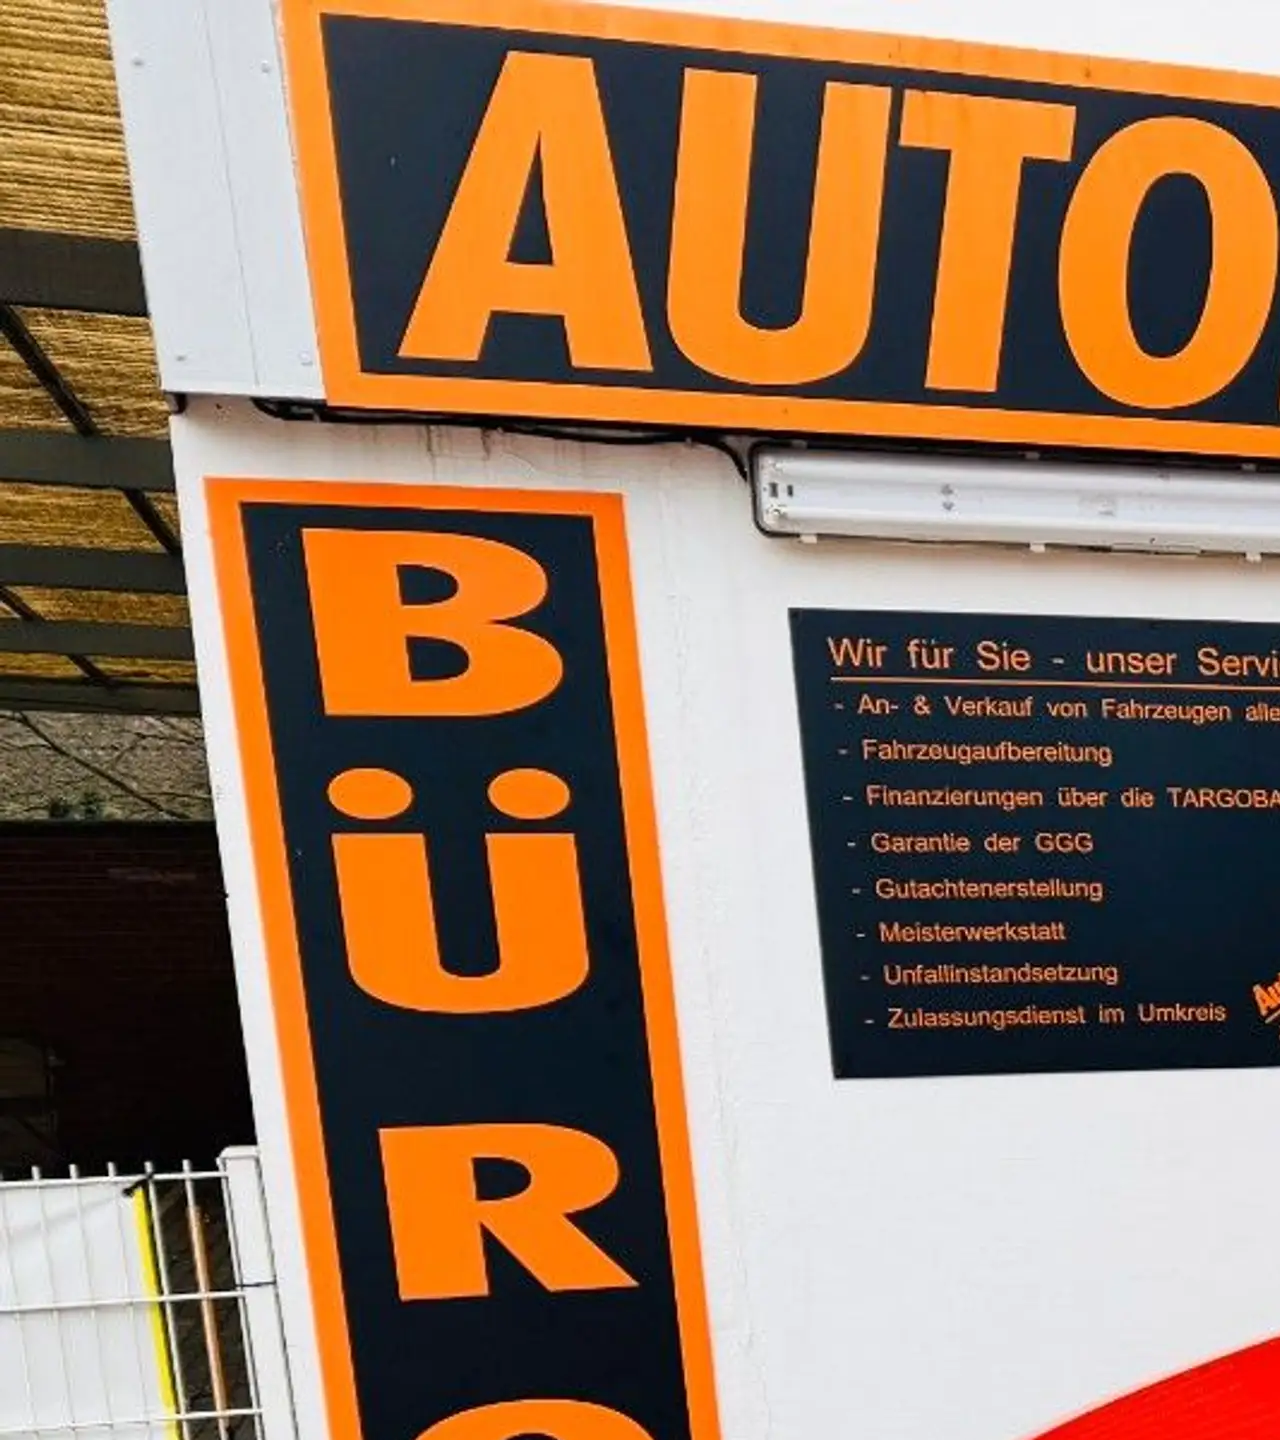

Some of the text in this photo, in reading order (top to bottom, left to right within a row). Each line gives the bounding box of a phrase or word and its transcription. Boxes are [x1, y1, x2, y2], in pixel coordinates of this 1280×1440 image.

[827, 637, 887, 669] Wir
[907, 639, 953, 669] für
[976, 640, 1031, 672] Sie
[1086, 651, 1177, 675] unser
[857, 694, 899, 715] An-
[913, 696, 931, 715] &
[944, 695, 1033, 717] Verkauf
[1046, 700, 1087, 718] von
[1101, 699, 1232, 724] Fahrzeugen
[862, 739, 1113, 767] Fahrzeugaufbereitung
[865, 784, 1043, 811] Finanzierungen
[1058, 787, 1108, 808] über
[1120, 787, 1154, 808] die
[870, 833, 970, 853] Garantie
[984, 834, 1021, 853] der
[1035, 833, 1093, 853] GGG
[875, 878, 1104, 902] Gutachtenerstellung
[879, 922, 1066, 943] Meisterwerkstatt
[883, 963, 1119, 985] Unfallinstandsetzung
[888, 1005, 1086, 1030] Zulassungsdienst
[1099, 1004, 1125, 1024] im
[1138, 1002, 1227, 1023] Umkreis
